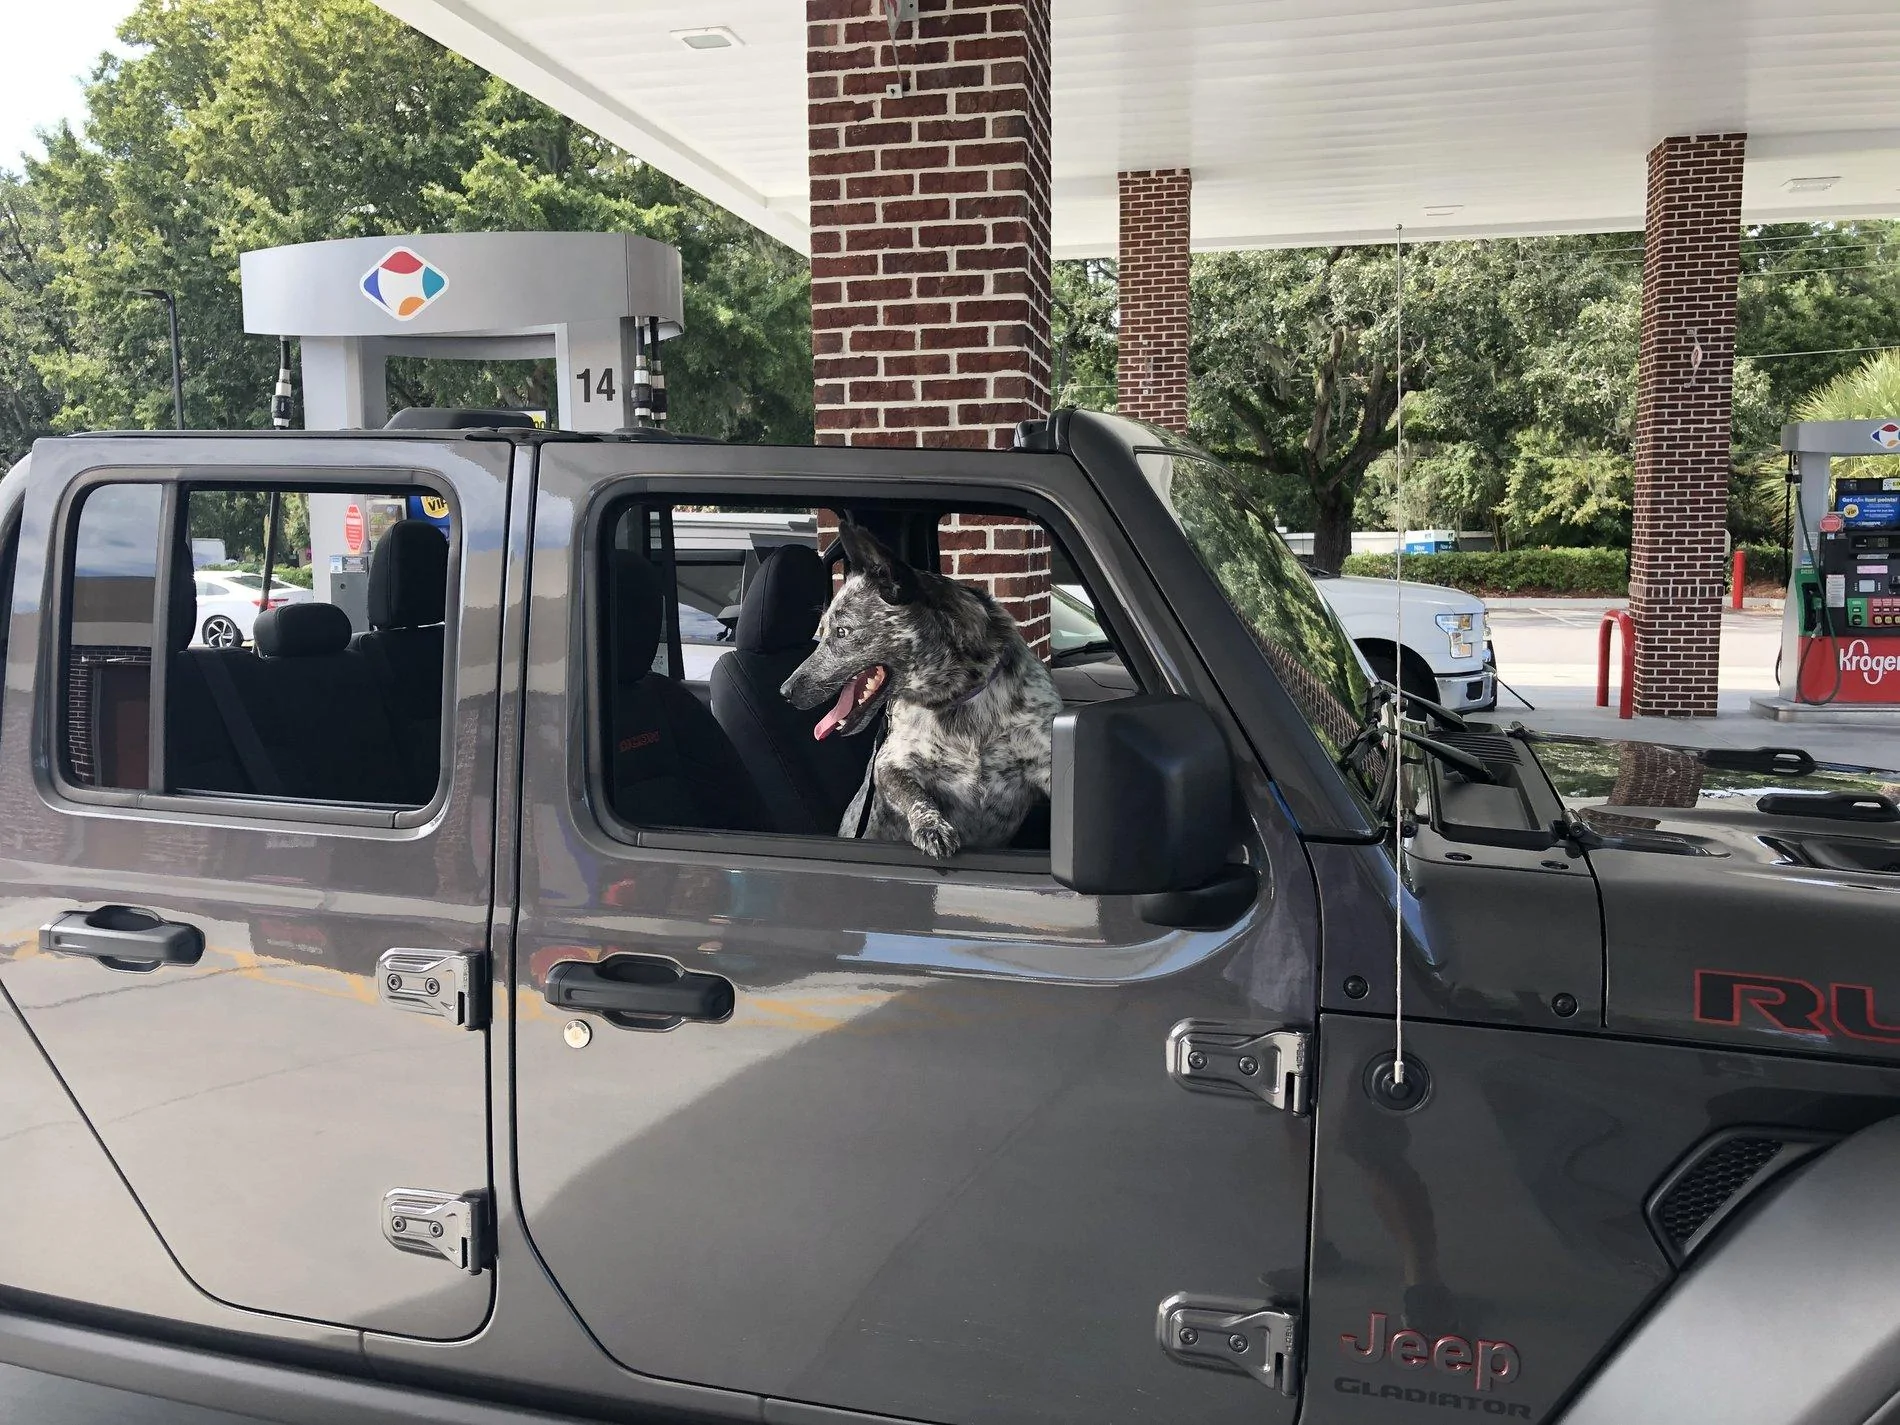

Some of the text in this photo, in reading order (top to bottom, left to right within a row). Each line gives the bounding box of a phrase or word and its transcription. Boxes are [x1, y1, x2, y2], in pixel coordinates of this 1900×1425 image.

[576, 367, 616, 403] 14
[428, 499, 447, 511] VIP
[1341, 1312, 1521, 1393] Jeep
[1334, 1376, 1531, 1420] GLADIATOR
